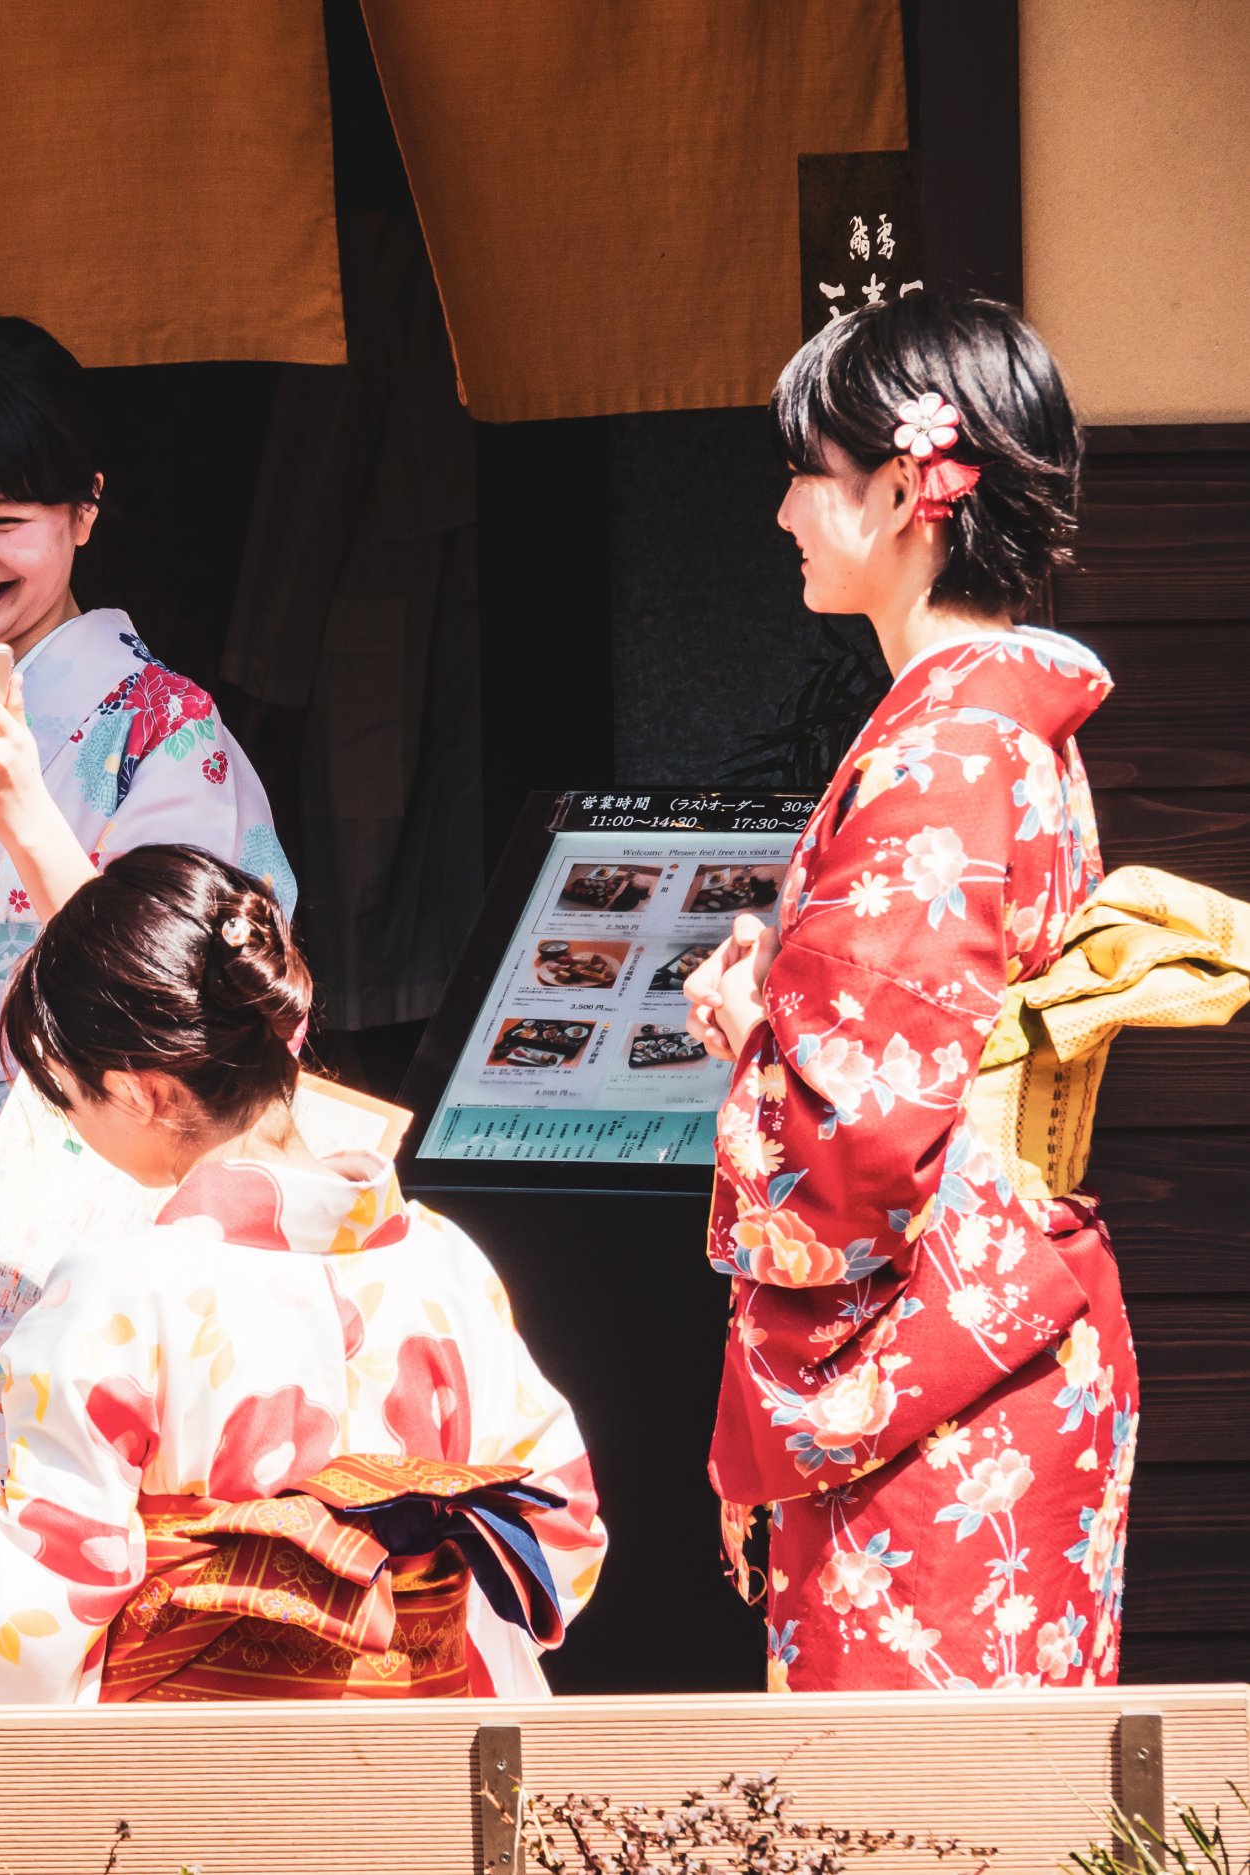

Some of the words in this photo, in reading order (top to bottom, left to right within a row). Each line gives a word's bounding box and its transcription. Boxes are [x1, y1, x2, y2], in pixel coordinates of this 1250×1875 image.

[581, 796, 651, 811] 営業時間
[622, 849, 663, 857] Welcome
[668, 849, 697, 857] Please
[699, 849, 716, 857] feel
[717, 849, 737, 857] free
[748, 849, 768, 857] visit
